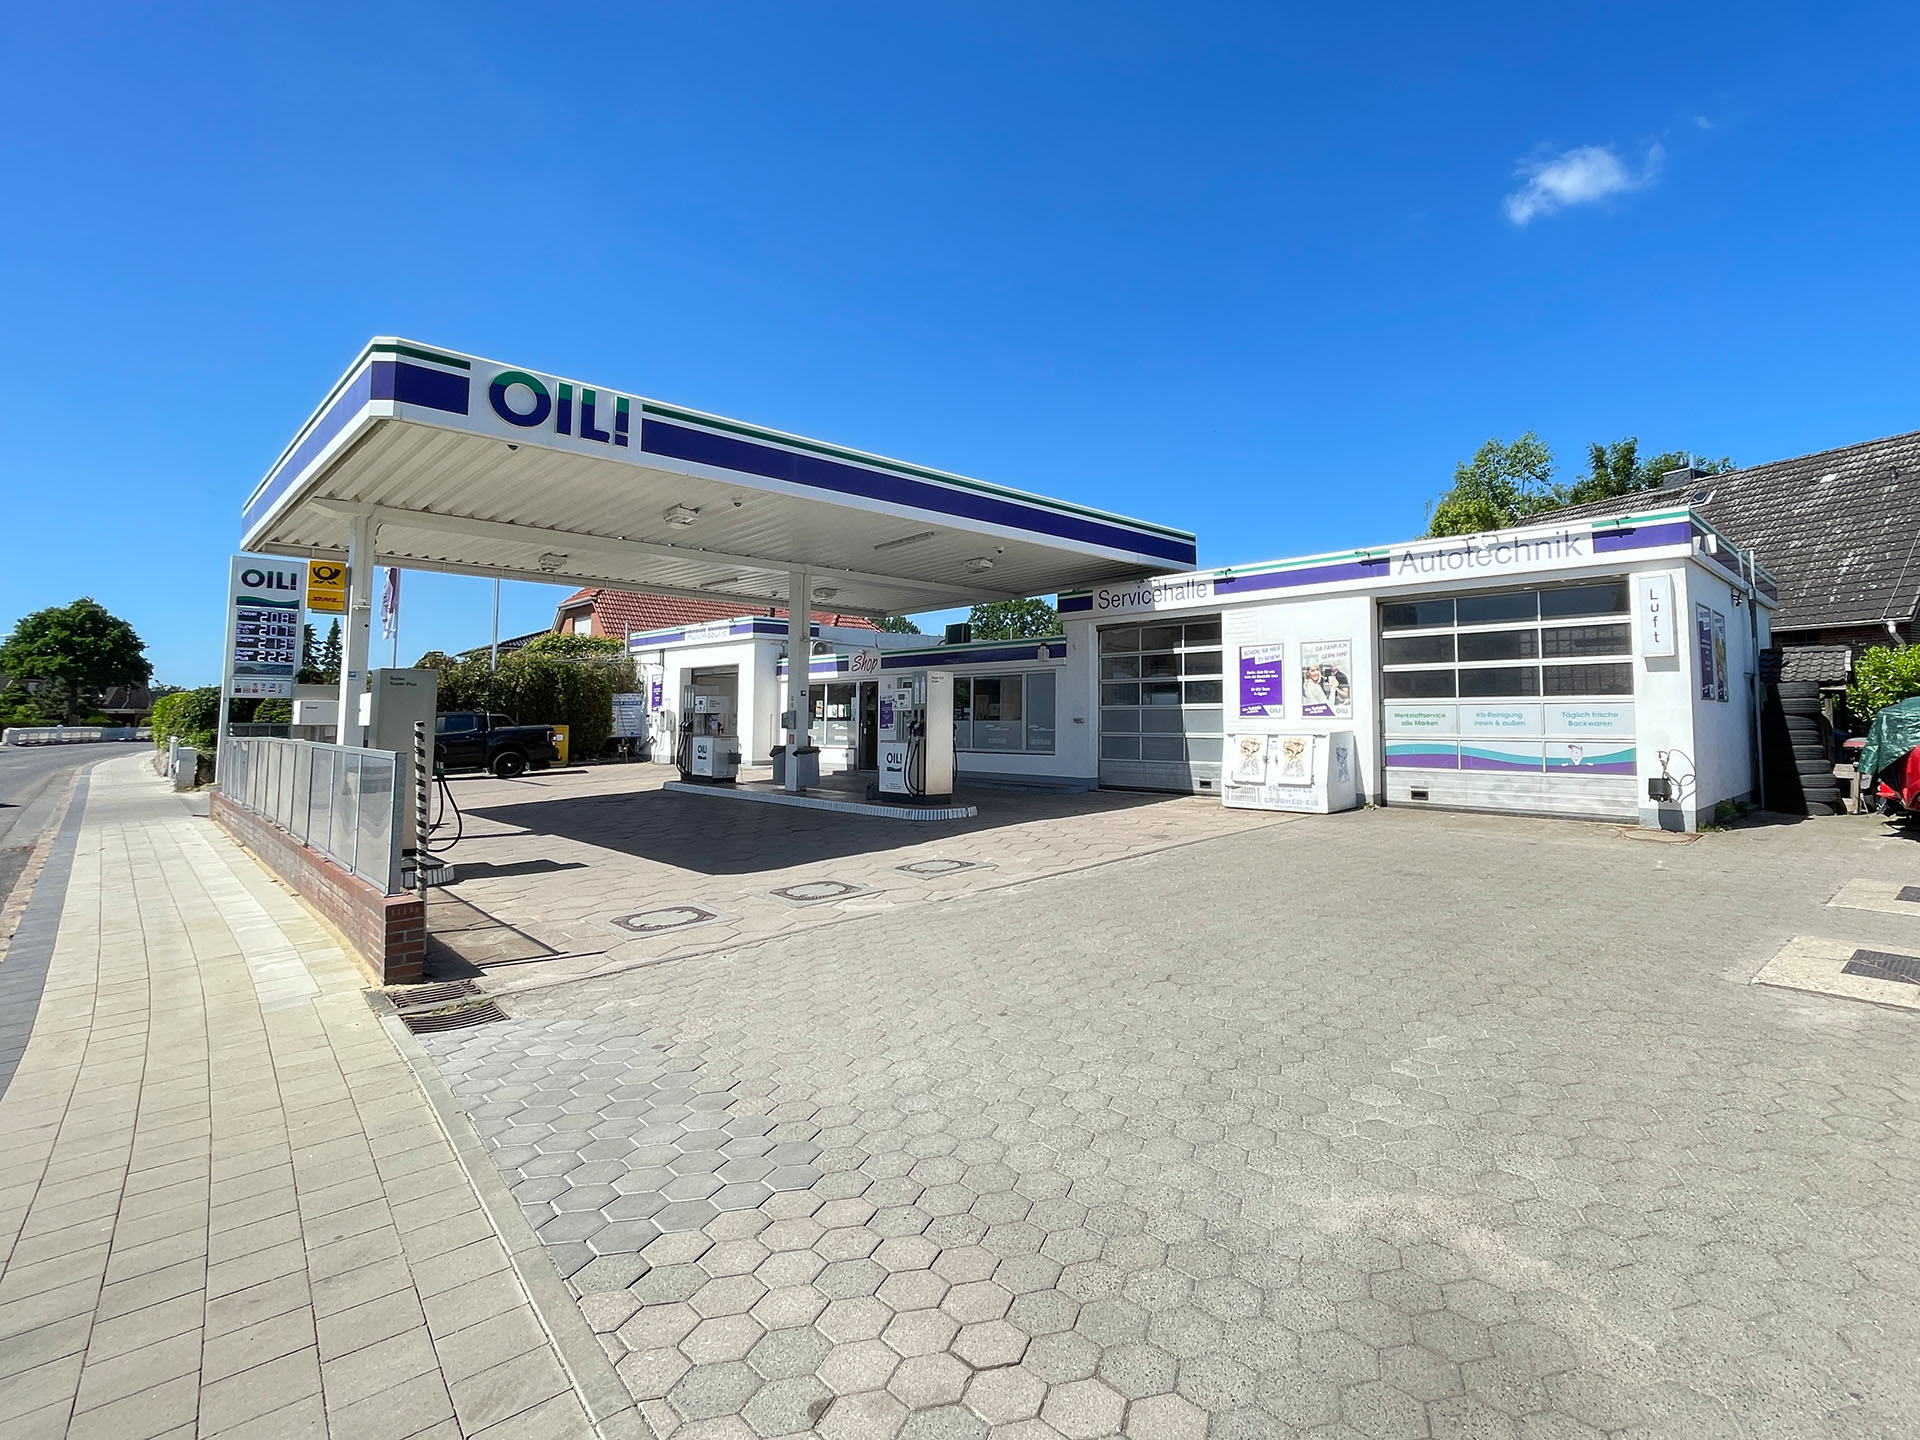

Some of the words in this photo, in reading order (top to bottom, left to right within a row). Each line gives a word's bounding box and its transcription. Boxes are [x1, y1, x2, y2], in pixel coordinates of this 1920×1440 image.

[488, 371, 629, 447] OIL!
[1398, 530, 1582, 575] Autotechnik
[241, 569, 297, 590] OIL!
[1098, 578, 1207, 609] Servicehalle
[1649, 588, 1660, 643] Luft
[851, 655, 878, 674] Shop
[1561, 711, 1590, 719] Täglich
[886, 752, 903, 764] OIL!
